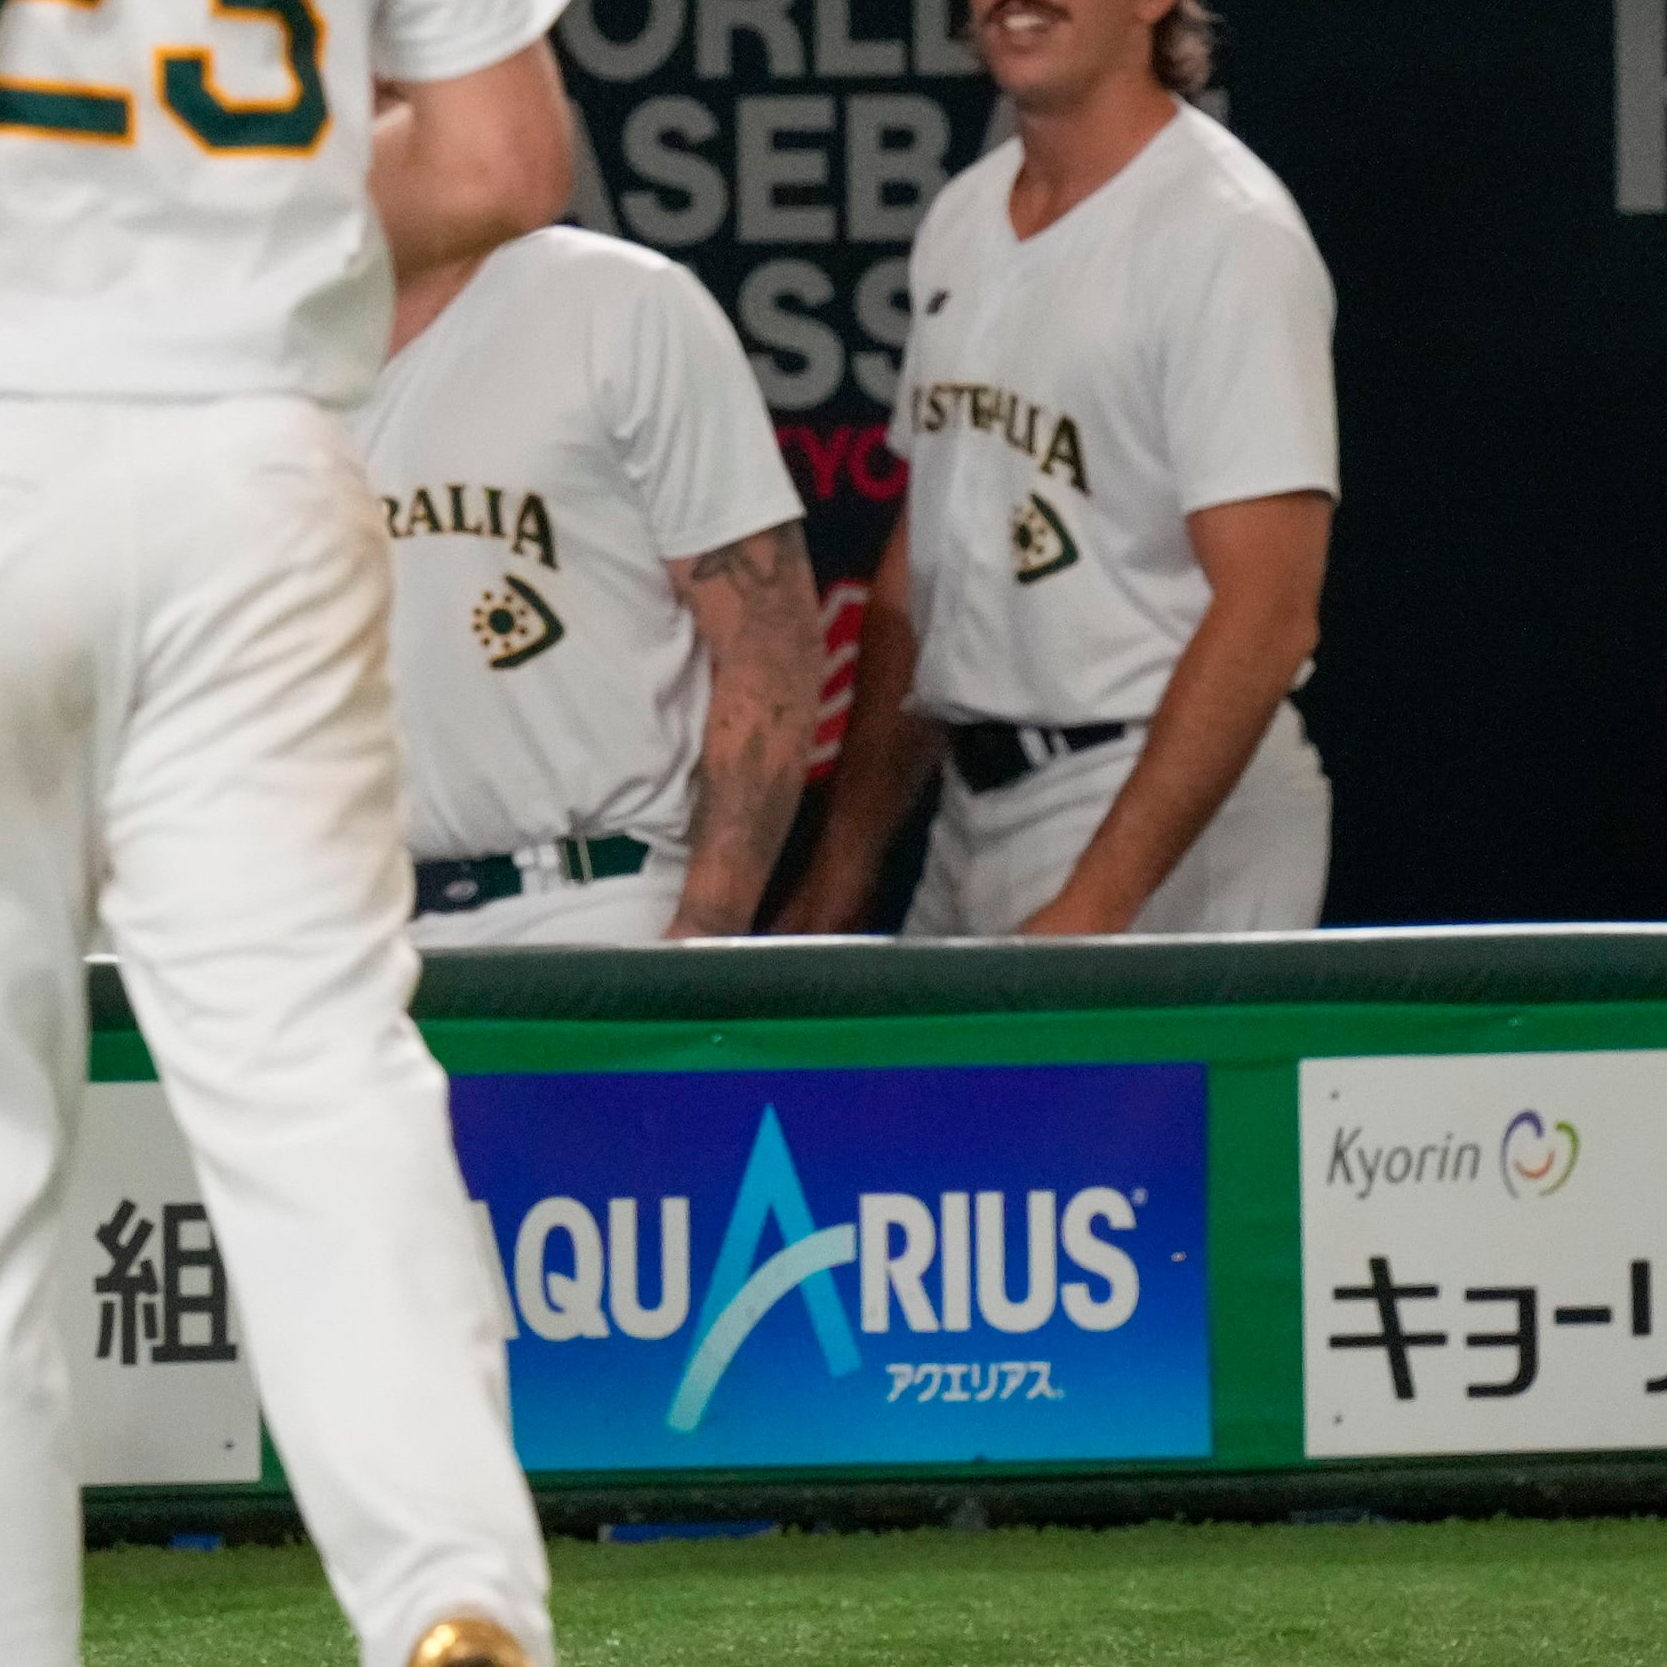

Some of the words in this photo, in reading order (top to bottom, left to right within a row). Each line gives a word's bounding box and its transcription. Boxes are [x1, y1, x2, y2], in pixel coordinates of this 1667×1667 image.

[1326, 1125, 1482, 1200] Kyorin
[94, 1197, 238, 1366] 組
[885, 1360, 1054, 1403] アクエリアス
